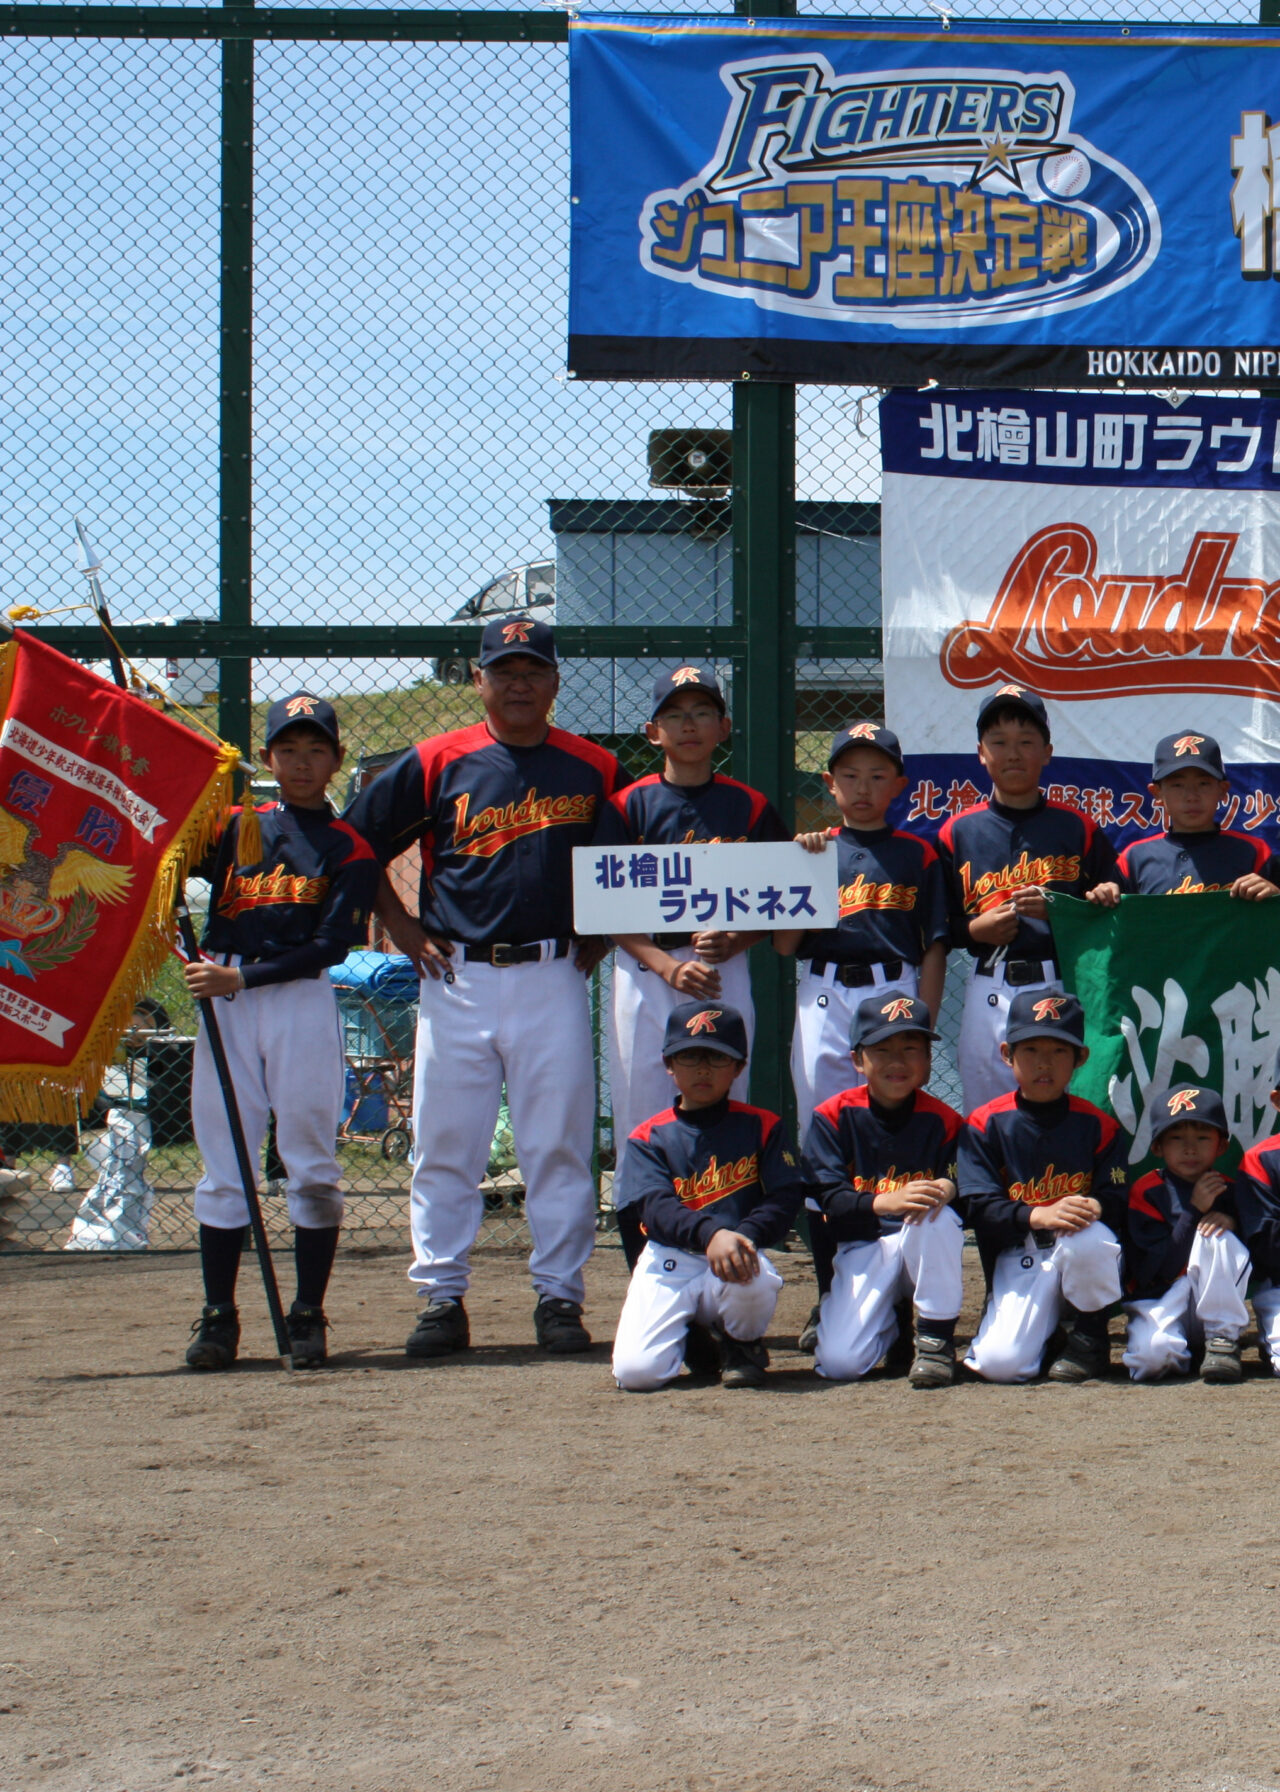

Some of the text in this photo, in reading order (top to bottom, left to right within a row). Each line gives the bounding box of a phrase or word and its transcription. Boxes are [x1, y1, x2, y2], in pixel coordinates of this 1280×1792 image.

[706, 63, 1066, 193] FIGHTERS
[650, 177, 1092, 302] ジュニア王座決定戦
[1087, 350, 1221, 377] HOKKAIDO
[594, 852, 693, 890] 北檜山
[957, 851, 1081, 906] Loudness
[658, 884, 818, 923] ラウドネス
